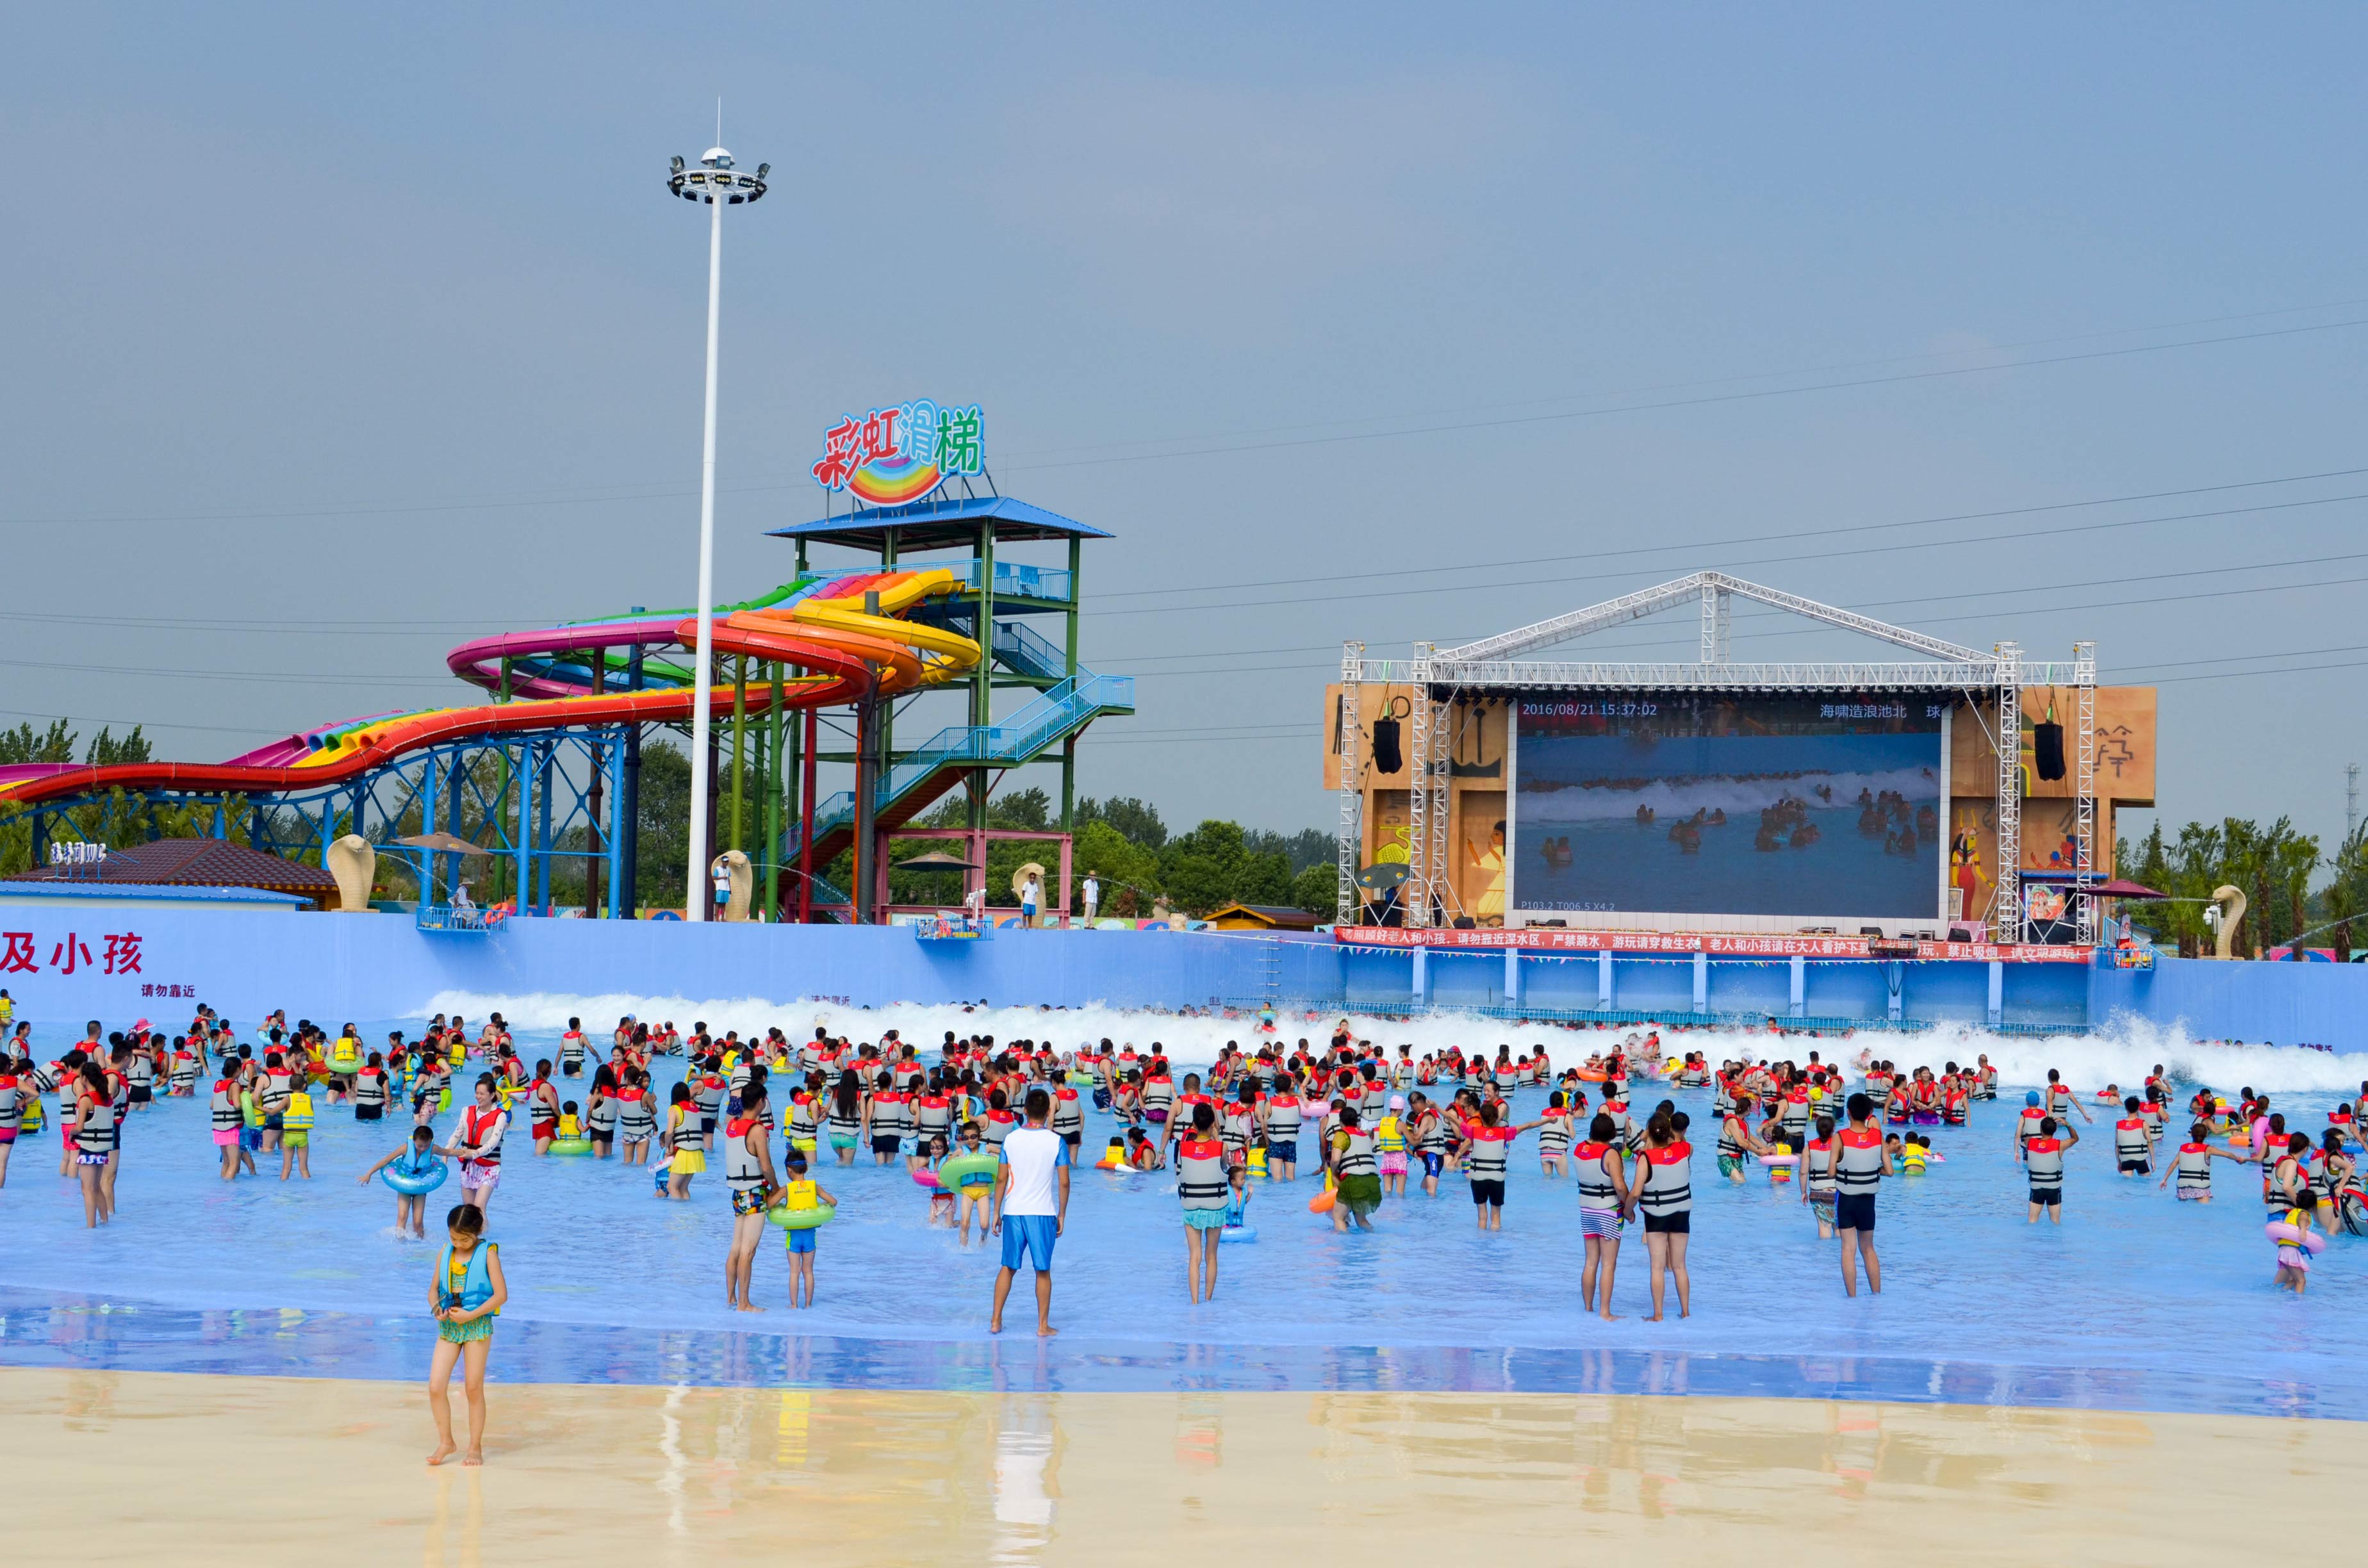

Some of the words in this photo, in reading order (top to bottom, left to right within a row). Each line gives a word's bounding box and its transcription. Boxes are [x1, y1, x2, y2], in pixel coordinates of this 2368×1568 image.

[812, 400, 981, 489] 彩虹滑梯
[1522, 704, 1595, 716] 2016/08/21
[1601, 704, 1657, 715] 15:37:02
[1820, 704, 1907, 719] 海啸造浪池北
[1521, 901, 1553, 910] P103.2
[1557, 901, 1590, 911] T006.5
[1593, 902, 1615, 911] X4.2
[0, 932, 142, 975] 及小孩
[141, 984, 195, 997] 请勿靠近
